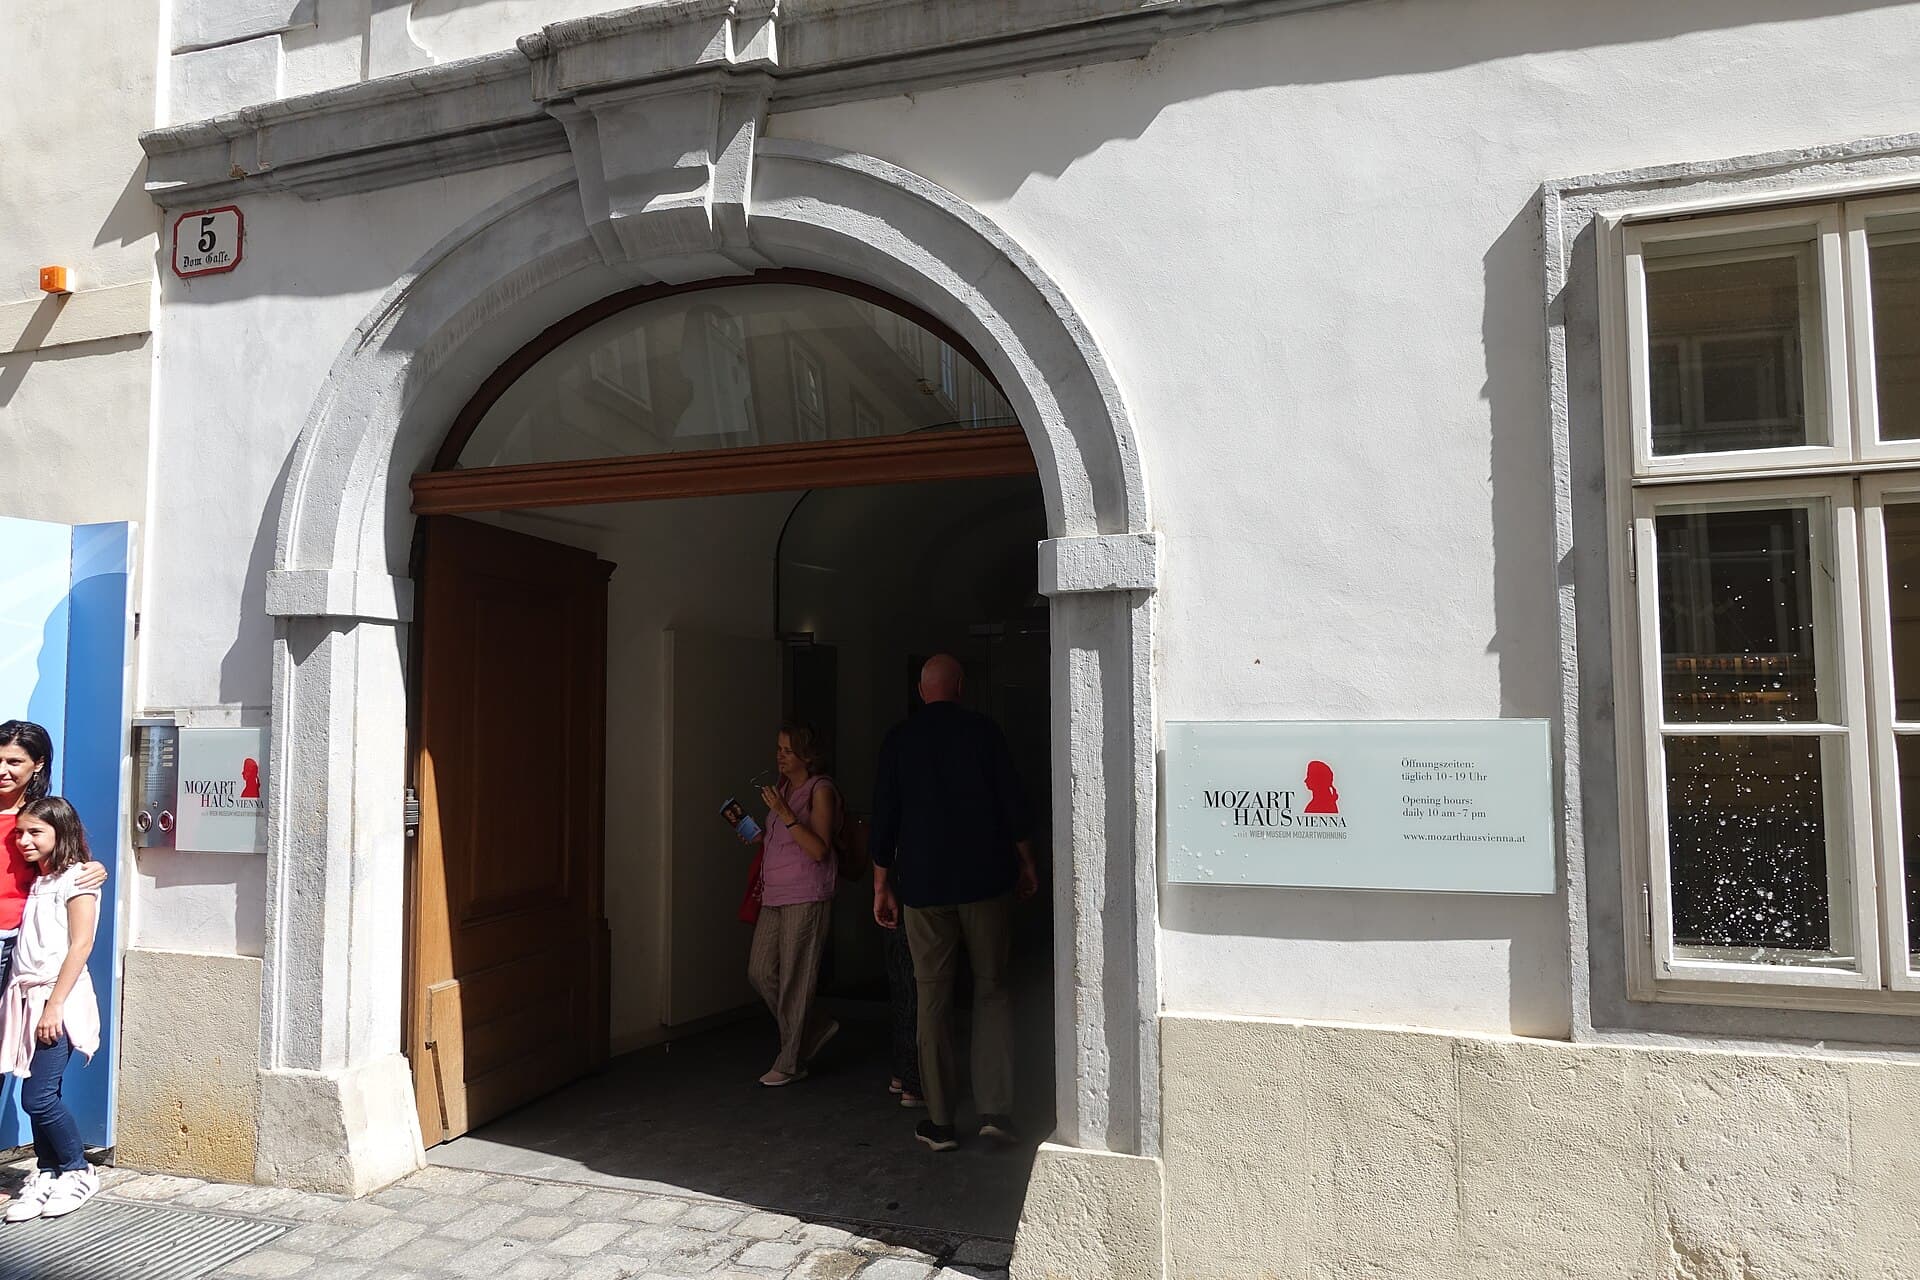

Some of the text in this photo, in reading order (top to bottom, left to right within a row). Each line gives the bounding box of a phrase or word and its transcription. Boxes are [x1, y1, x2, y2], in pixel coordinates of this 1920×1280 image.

[198, 216, 216, 253] 5
[183, 255, 202, 268] Dom
[1401, 757, 1474, 770] Öffnungszeiten:
[1401, 771, 1432, 784] täglich
[1436, 772, 1447, 781] 10
[1455, 772, 1466, 781] 19
[1469, 772, 1488, 781] Uhr
[184, 780, 236, 795] MOZART
[200, 793, 264, 809] HAUS VIENNA
[1203, 790, 1295, 809] MOZART
[1402, 795, 1473, 807] Opening hours:
[1233, 808, 1347, 828] HAUS VIENNA
[1402, 807, 1424, 820] daily
[1427, 807, 1439, 817] 10
[1471, 812, 1486, 820] pm
[1265, 830, 1292, 839] MUSEUM
[1292, 831, 1347, 840] MOZARTWOHNUNG
[1403, 832, 1525, 842] www.mozarthausvienna.at
